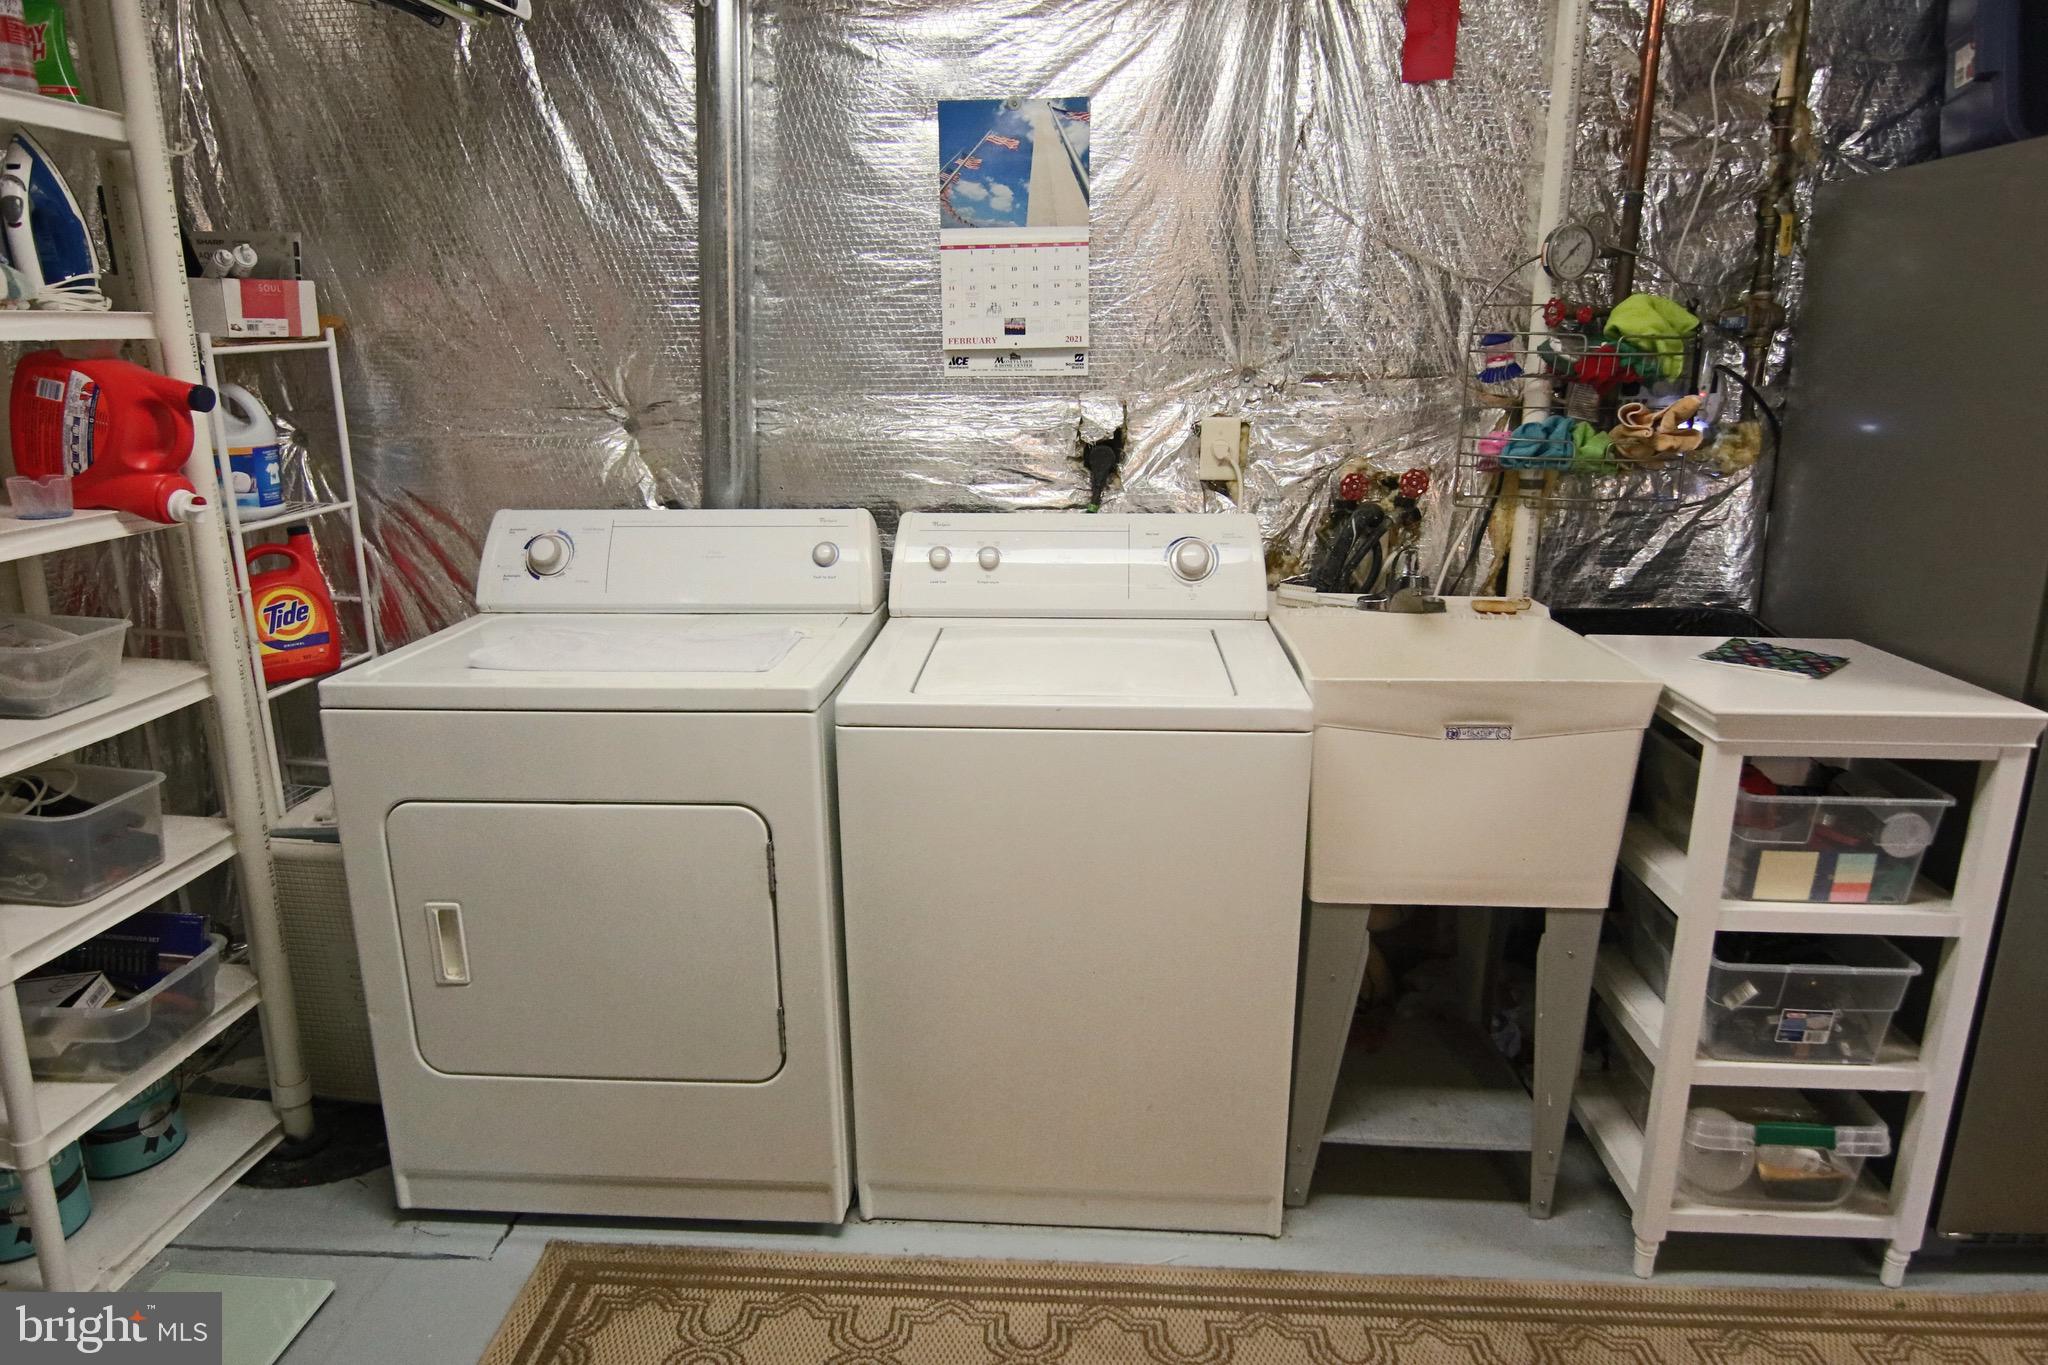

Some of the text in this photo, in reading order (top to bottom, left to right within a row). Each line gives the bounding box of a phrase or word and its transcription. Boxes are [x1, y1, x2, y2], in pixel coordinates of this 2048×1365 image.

[176, 250, 187, 284] PIPE
[258, 283, 282, 293] SOUL
[183, 293, 199, 371] CHARLOTTE
[948, 337, 998, 345] FEBRUARY
[948, 356, 969, 366] ACE
[262, 600, 310, 634] Tide
